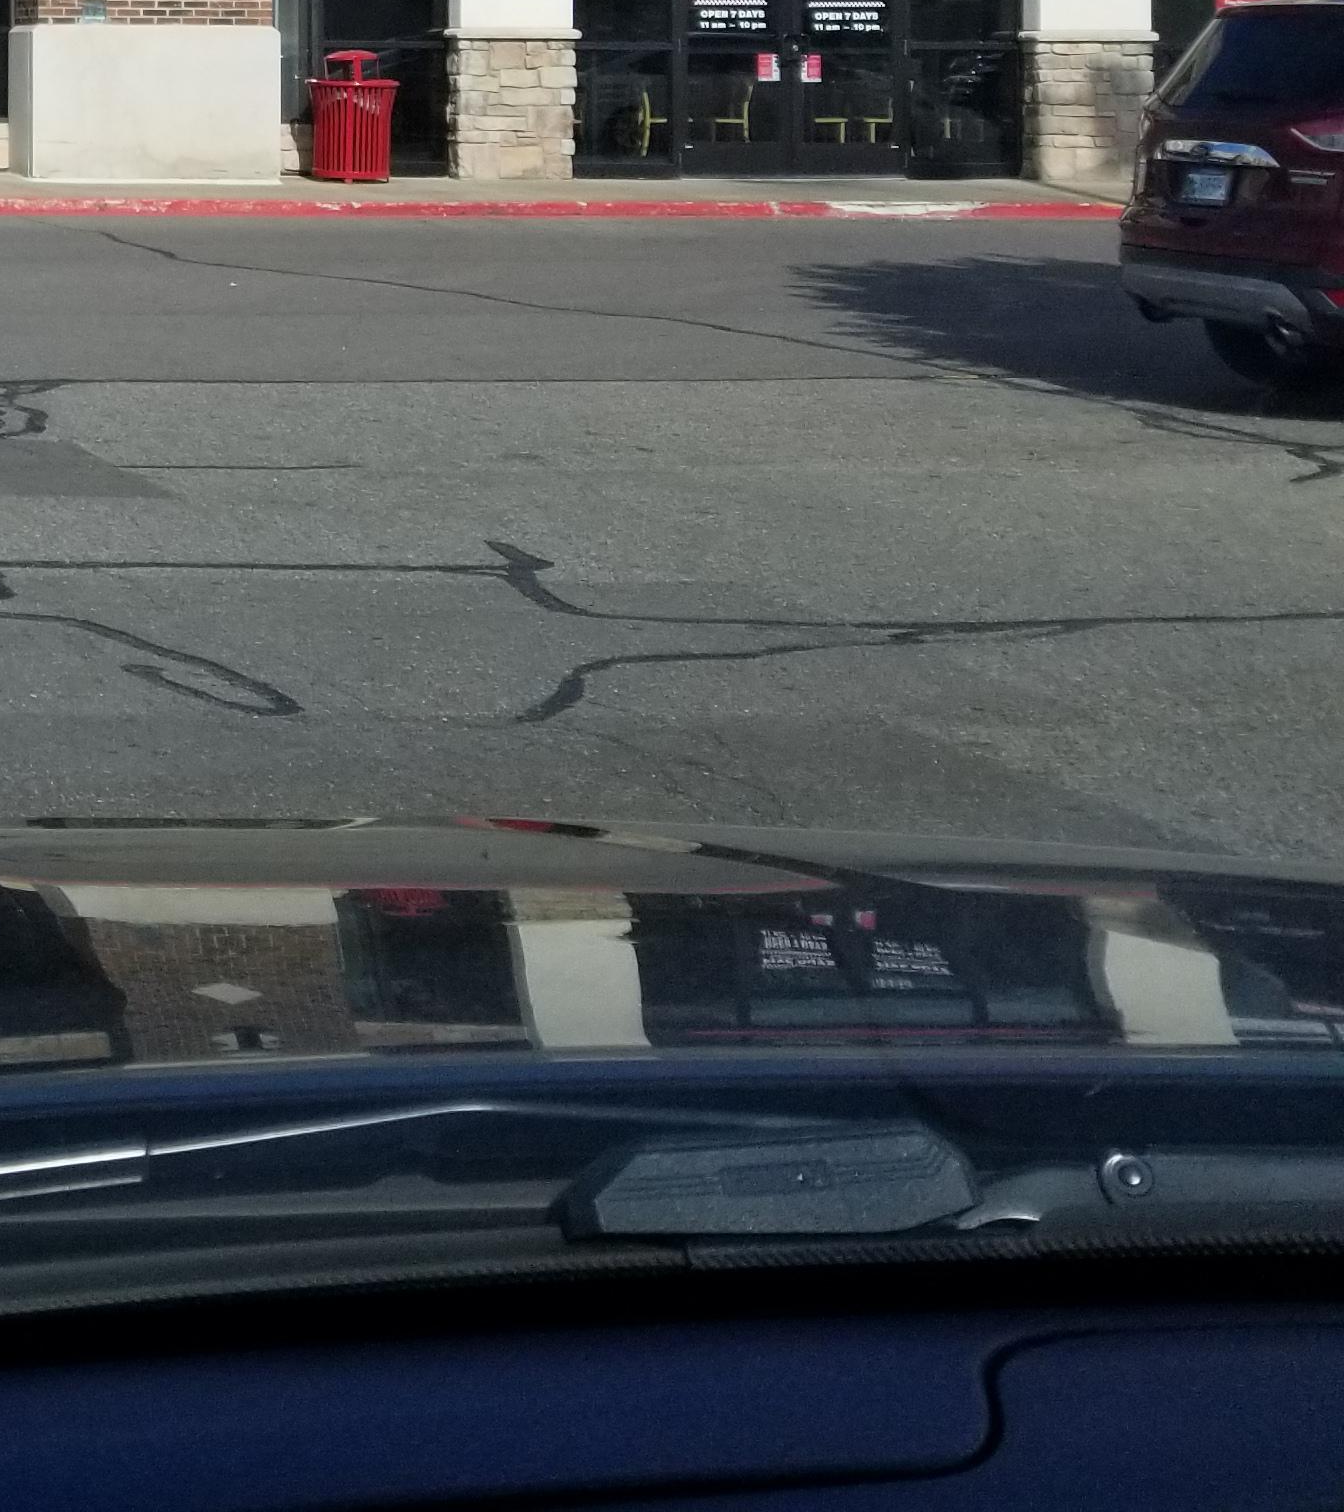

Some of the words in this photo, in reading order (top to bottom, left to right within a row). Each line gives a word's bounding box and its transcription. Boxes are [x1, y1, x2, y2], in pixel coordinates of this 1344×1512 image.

[700, 9, 729, 19] OPEN
[730, 9, 737, 19] 7
[738, 9, 766, 19] DAYS
[814, 11, 843, 21] OPEN
[844, 11, 851, 21] 7
[852, 11, 879, 21] DAYS
[700, 21, 709, 29] 11
[739, 21, 750, 29] 10
[751, 22, 767, 30] pm
[866, 24, 881, 32] pm
